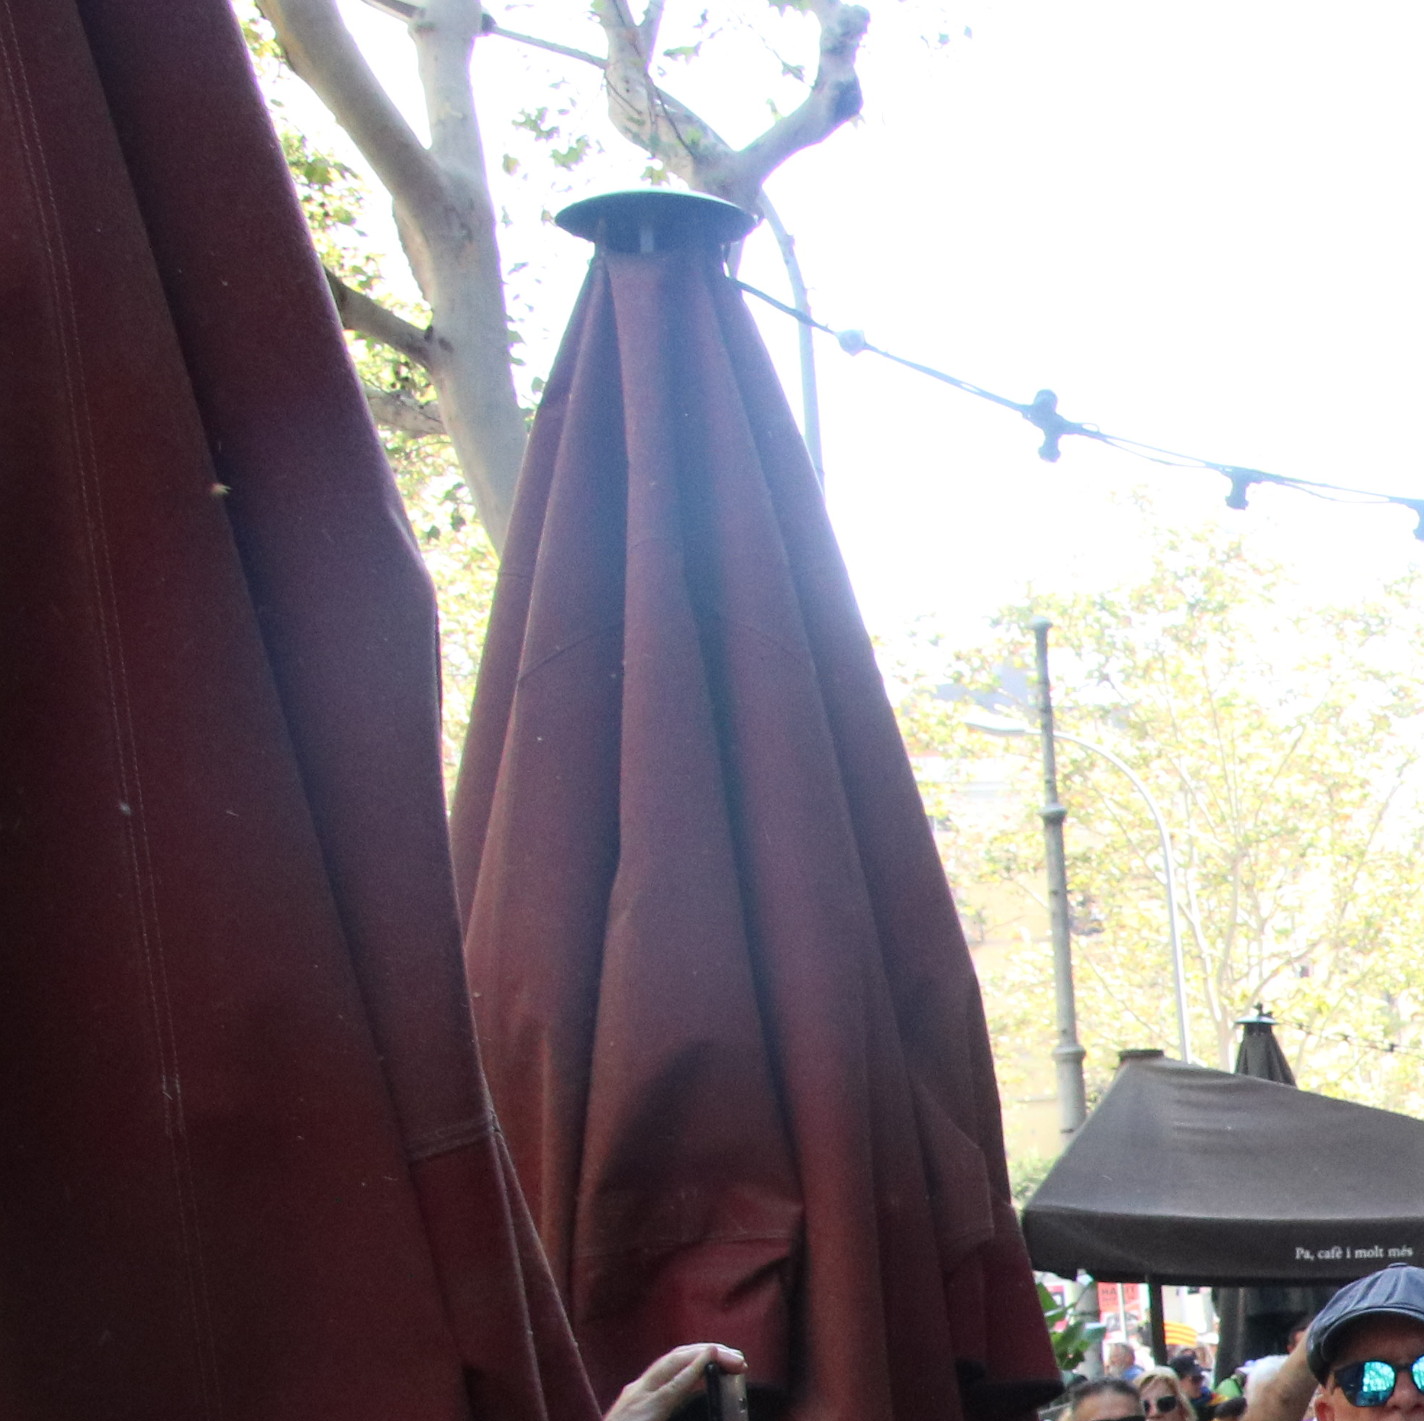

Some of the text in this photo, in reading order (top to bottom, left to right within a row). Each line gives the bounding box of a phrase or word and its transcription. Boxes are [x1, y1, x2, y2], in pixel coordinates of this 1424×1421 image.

[1295, 1246, 1314, 1260] Pa,
[1354, 1246, 1384, 1259] molt
[1388, 1245, 1413, 1257] més
